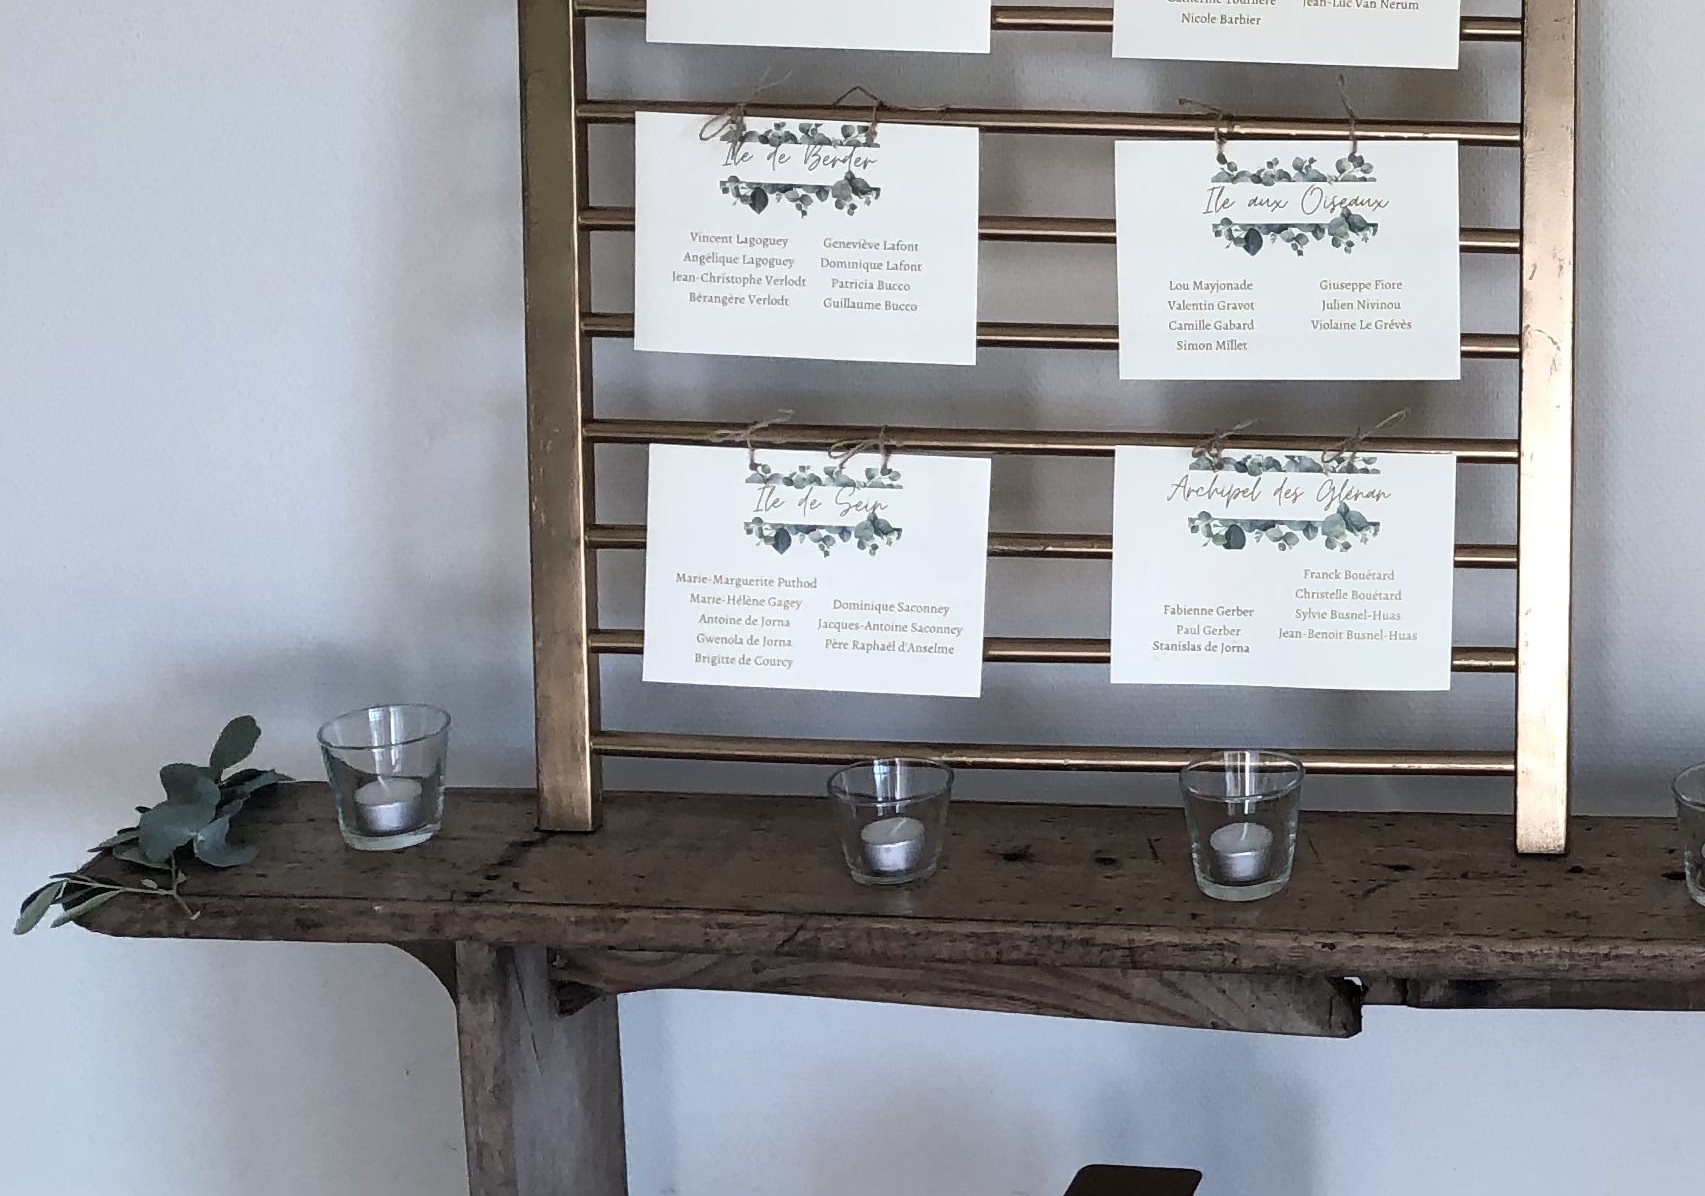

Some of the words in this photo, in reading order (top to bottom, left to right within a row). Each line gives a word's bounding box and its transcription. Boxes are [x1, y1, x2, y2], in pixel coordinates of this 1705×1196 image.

[1181, 12, 1217, 24] Nicole
[1220, 13, 1261, 26] Barbier
[767, 145, 791, 172] de
[1247, 195, 1289, 209] aux
[1301, 184, 1390, 215] Oiseaux
[1319, 279, 1371, 293] Giuseppe
[1375, 279, 1403, 290] Fiore
[689, 292, 745, 307] Bérangère
[823, 297, 881, 310] Guillaume
[885, 300, 917, 312] Bucco
[1169, 319, 1211, 331] Camille
[1214, 318, 1254, 331] Gabard
[1177, 339, 1212, 351] Simon
[1215, 339, 1247, 351] Millet
[1166, 474, 1262, 508] Archipel
[1273, 476, 1305, 504] des
[798, 487, 823, 518] de
[834, 486, 888, 518] Sein
[1304, 568, 1341, 580] Franck
[833, 599, 895, 615] Dominique
[897, 602, 950, 617] Saconney
[1164, 604, 1214, 616] Fabienne
[1216, 605, 1254, 617] Gerber
[698, 613, 742, 625] Antoine
[745, 614, 758, 626] de
[761, 616, 790, 628] Jorna
[1177, 624, 1200, 635] Paul
[1203, 624, 1241, 636] Gerber
